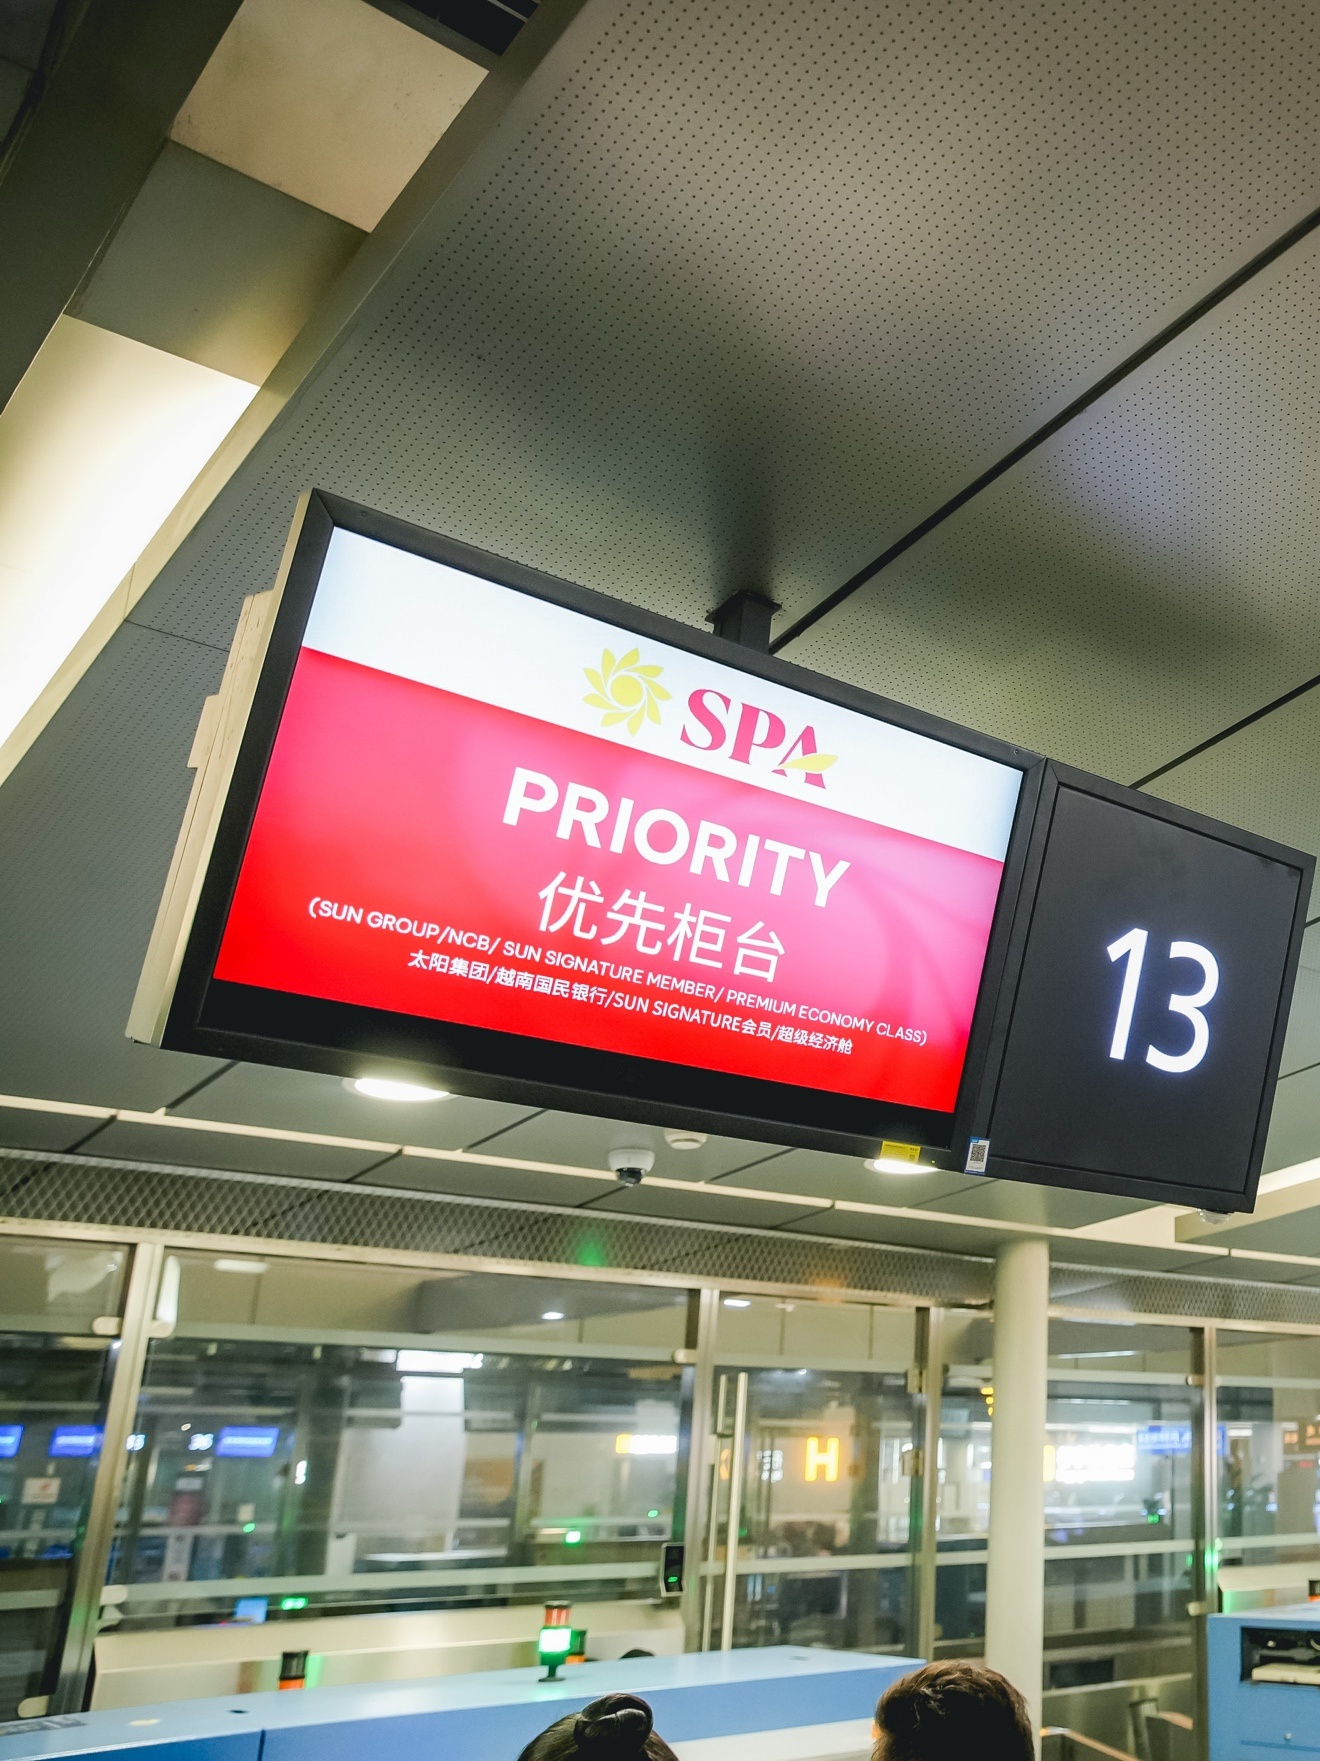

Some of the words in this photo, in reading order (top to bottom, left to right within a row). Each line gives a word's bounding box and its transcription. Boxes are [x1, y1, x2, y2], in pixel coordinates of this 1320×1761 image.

[680, 688, 834, 790] SPA
[502, 766, 851, 909] PRIORITY
[308, 897, 363, 924] (SUN
[366, 911, 501, 954] GROUP/NCB/
[502, 941, 542, 963] SUN
[544, 950, 645, 985] SIGNATURE
[646, 971, 726, 1004] MEMBER/
[726, 989, 797, 1017] PREMIUM
[798, 1005, 875, 1033] ECONOMY
[876, 1022, 928, 1046] CLASS)
[538, 870, 786, 983] 优先柜台
[1106, 928, 1219, 1073] 13
[805, 1437, 839, 1482] H
